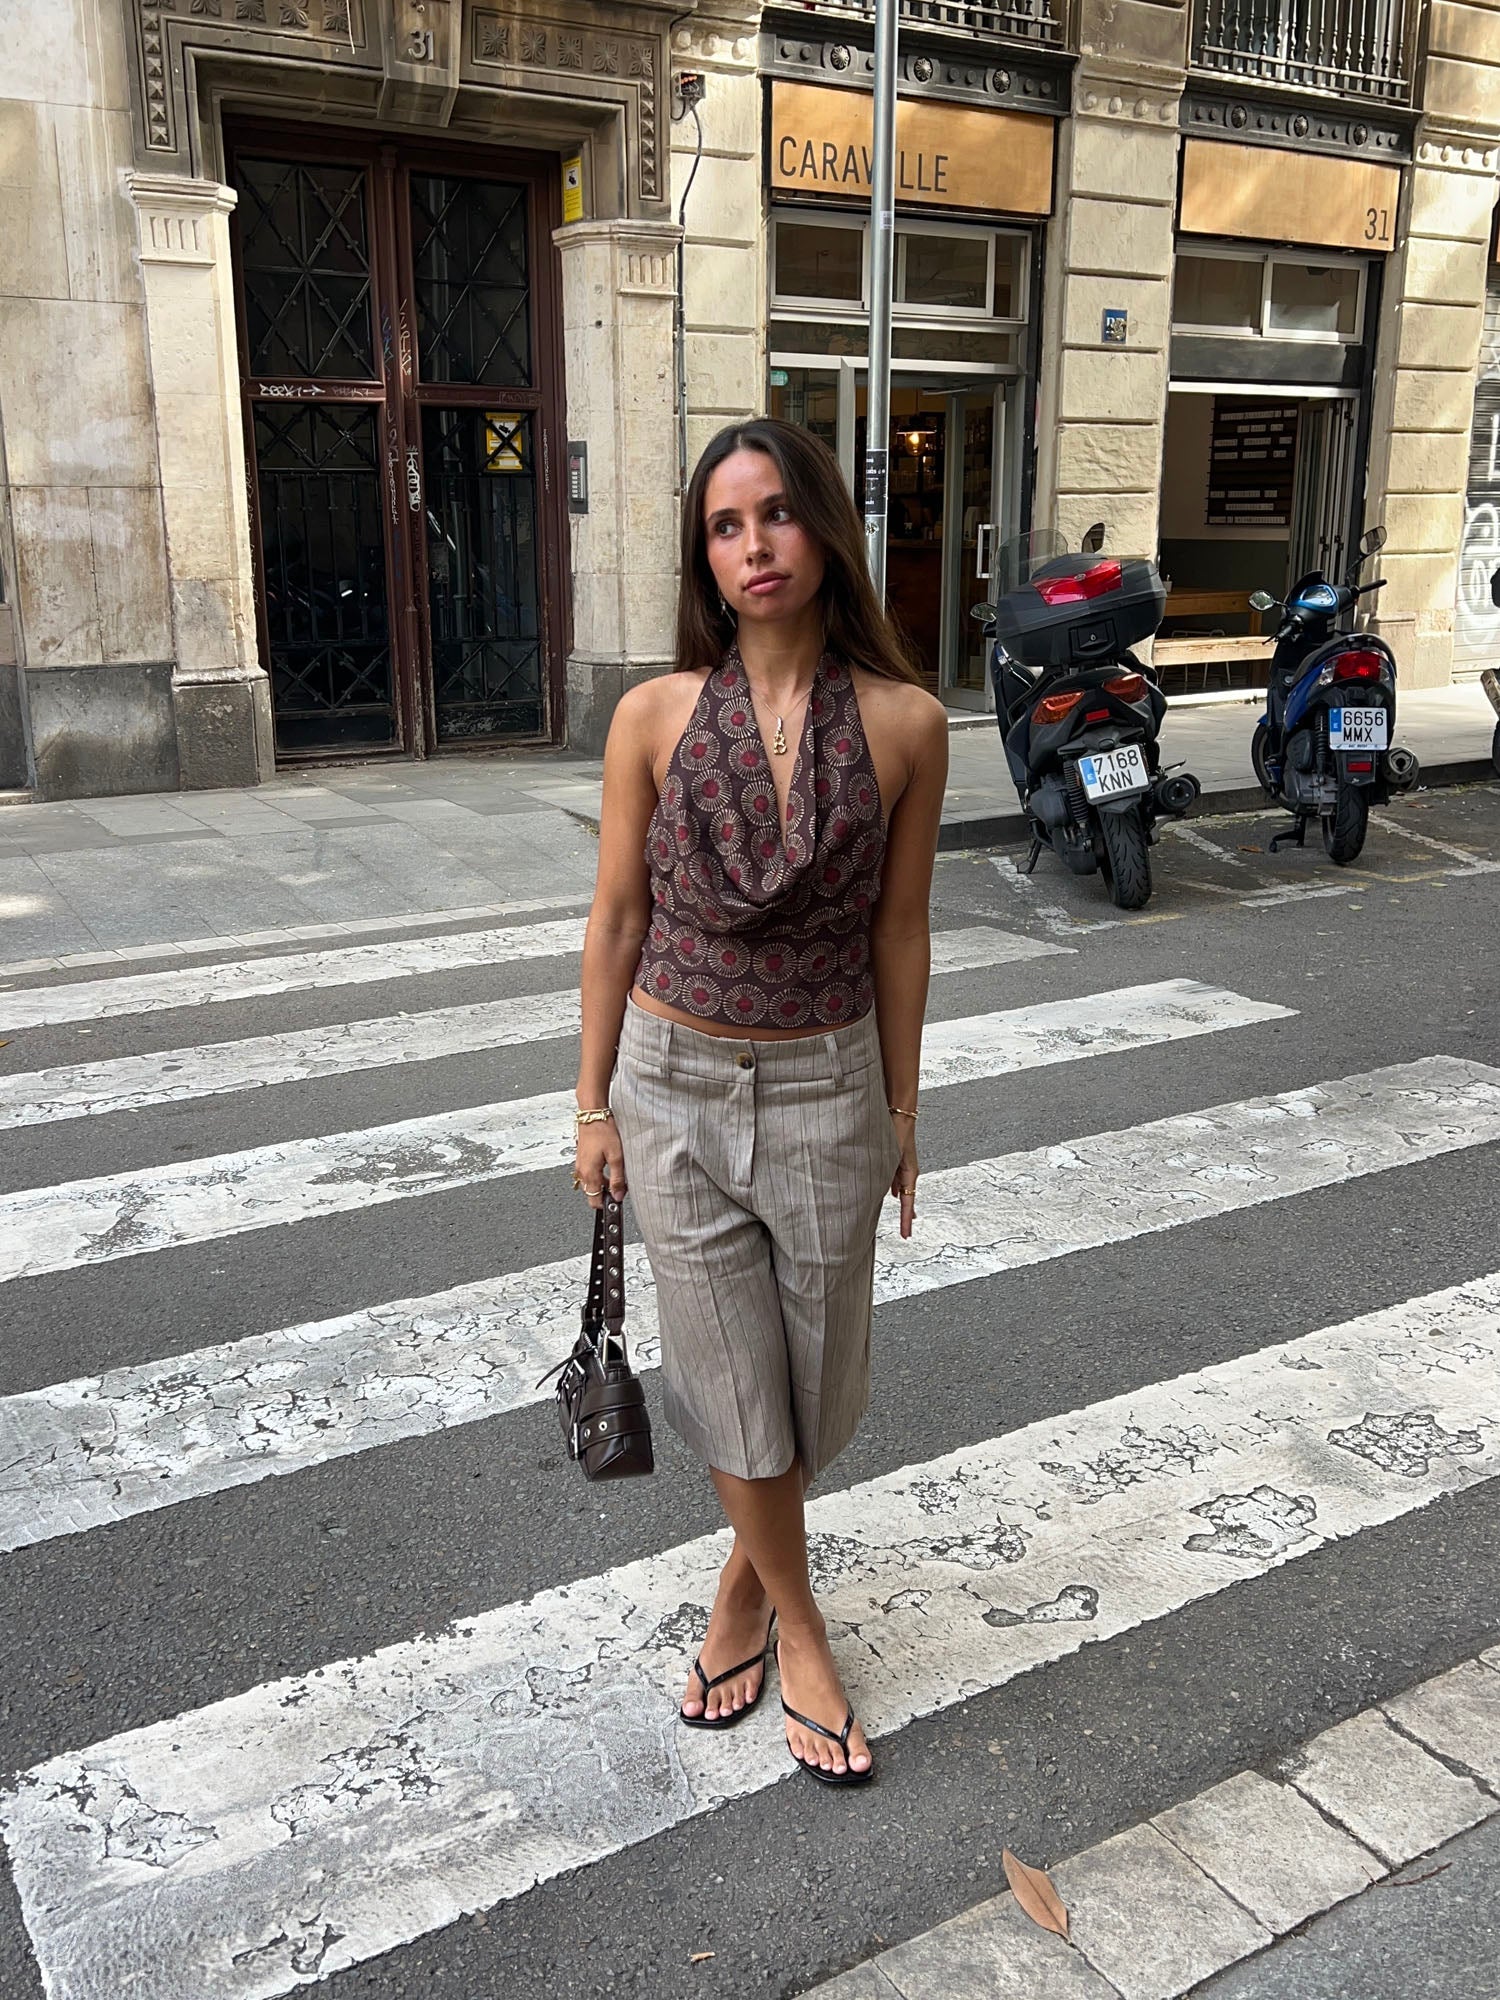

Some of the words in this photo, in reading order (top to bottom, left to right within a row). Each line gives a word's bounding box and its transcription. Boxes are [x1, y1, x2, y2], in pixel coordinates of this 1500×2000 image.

[408, 27, 434, 60] 31
[779, 135, 949, 193] CARAVLLE
[1364, 207, 1389, 241] 31
[1343, 710, 1384, 727] 6656
[1343, 727, 1373, 743] MMX
[1093, 749, 1139, 775] 7168
[1098, 769, 1134, 793] KNN
